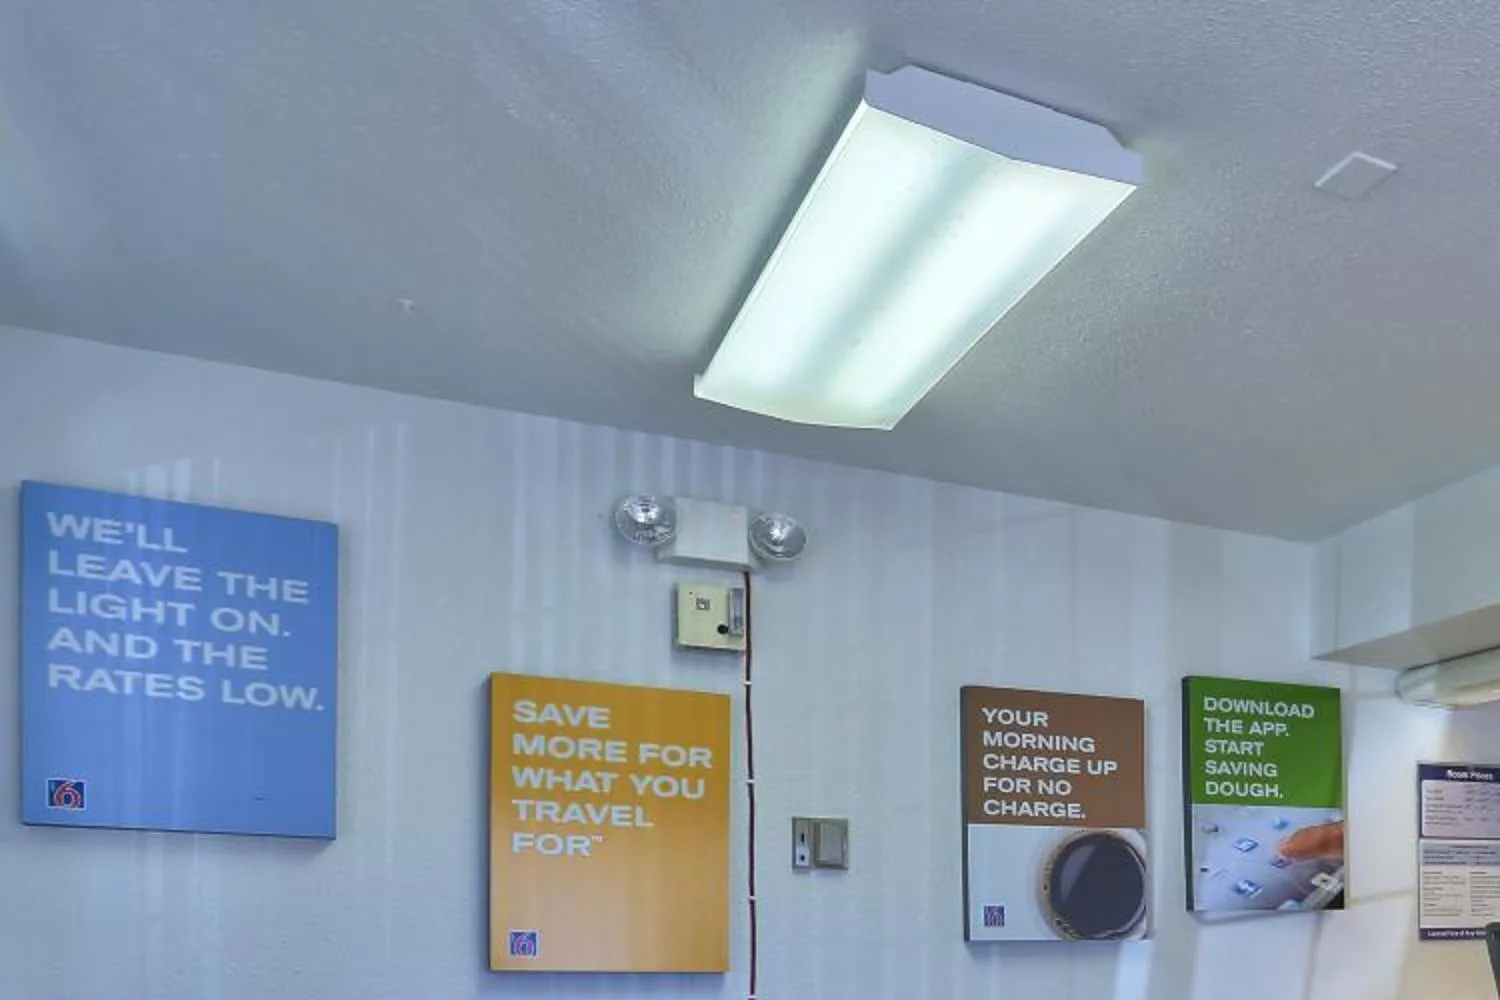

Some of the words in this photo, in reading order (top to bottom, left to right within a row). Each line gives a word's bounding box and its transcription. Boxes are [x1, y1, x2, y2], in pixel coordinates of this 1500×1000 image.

[47, 511, 188, 553] WE'LL
[49, 550, 203, 591] LEAVE
[217, 571, 309, 604] THE
[49, 589, 197, 627] LIGHT
[210, 607, 291, 637] ON.
[48, 627, 157, 659] AND
[174, 639, 269, 670] THE
[48, 664, 205, 701] RATES
[222, 680, 326, 712] LOW.
[512, 700, 610, 729] SAVE
[982, 708, 1049, 727] YOUR
[1203, 697, 1315, 718] DOWNLOAD
[1203, 717, 1243, 734] THE
[1249, 721, 1289, 736] APP.
[513, 733, 627, 762] MORE
[639, 743, 713, 768] FOR
[983, 730, 1095, 753] MORNING
[1205, 739, 1264, 756] START
[983, 753, 1080, 774] CHARGE
[1088, 760, 1117, 775] UP
[1205, 759, 1278, 777] SAVING
[512, 766, 619, 793] WHAT
[629, 773, 705, 799] YOU
[983, 777, 1031, 793] FOR
[1038, 780, 1072, 795] NO
[1205, 781, 1283, 798] DOUGH.
[512, 799, 654, 827] TRAVEL
[983, 799, 1086, 819] CHARGE.
